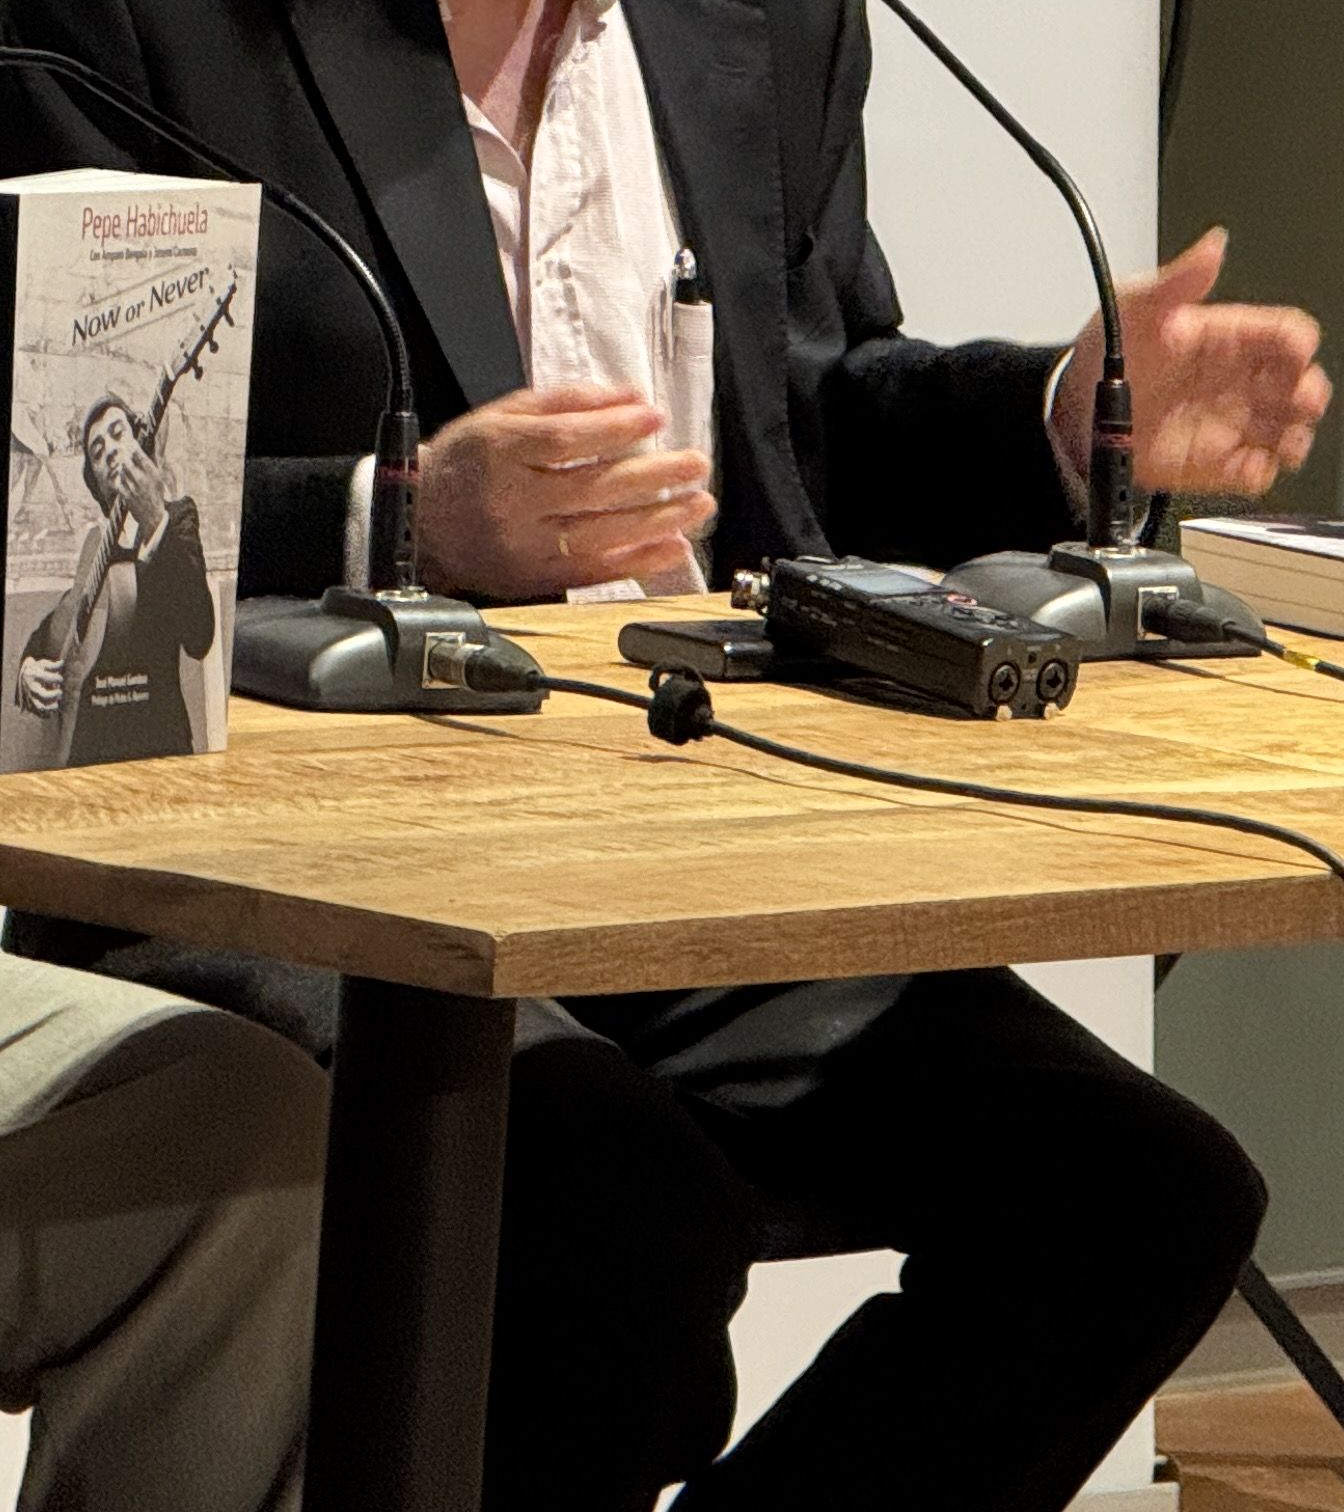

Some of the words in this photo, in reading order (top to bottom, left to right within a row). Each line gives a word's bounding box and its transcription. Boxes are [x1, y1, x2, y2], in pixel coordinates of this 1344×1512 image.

[82, 206, 122, 248] Pepe
[126, 201, 208, 238] Habichuela
[72, 306, 122, 347] Now
[125, 300, 145, 323] or
[150, 267, 209, 313] Never
